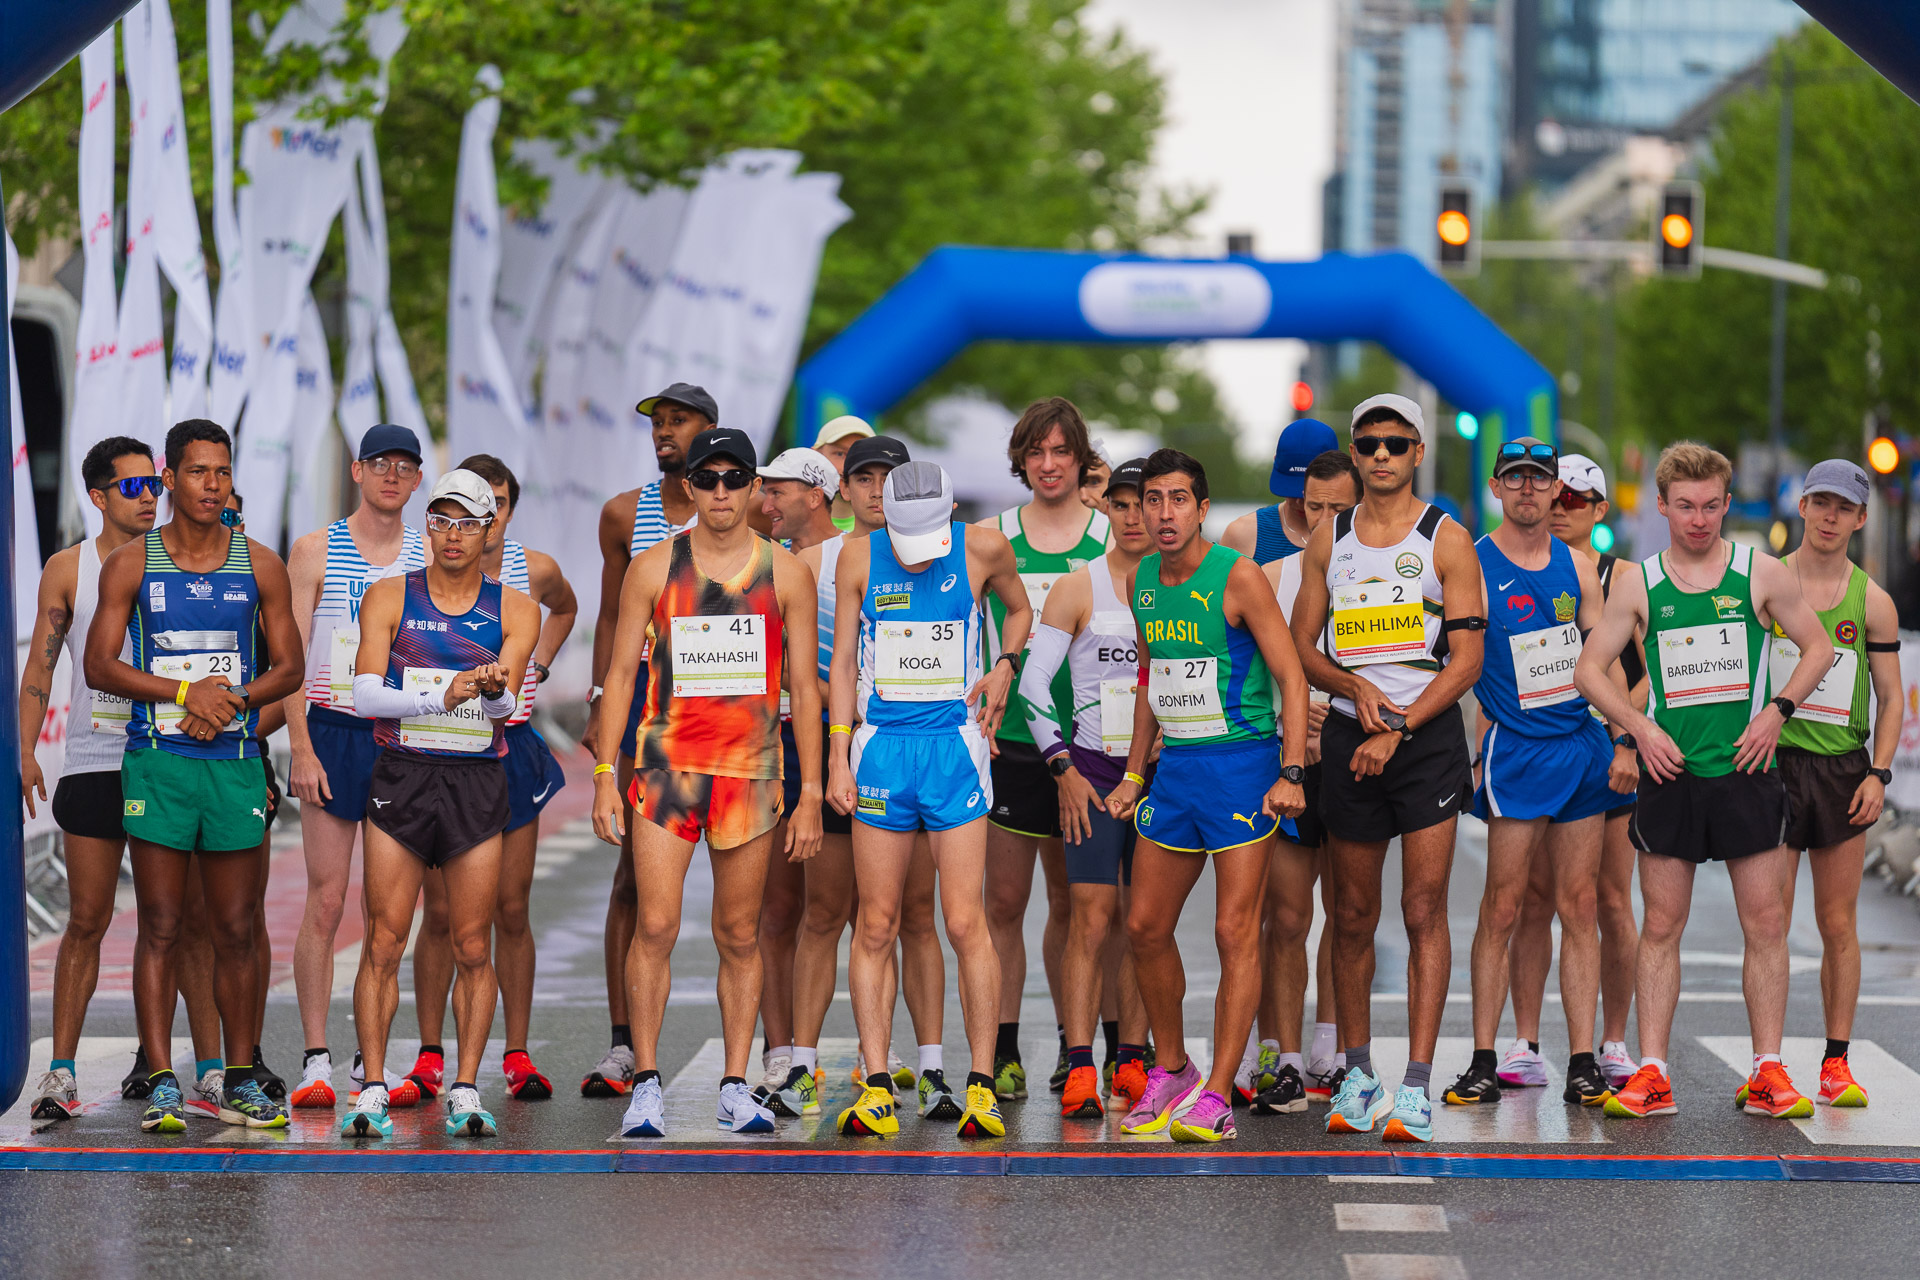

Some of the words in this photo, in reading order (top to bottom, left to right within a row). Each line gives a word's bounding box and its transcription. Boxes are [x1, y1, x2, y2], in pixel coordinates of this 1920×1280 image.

[1399, 556, 1419, 567] RKS
[872, 581, 914, 595] 大塚製薬
[1392, 585, 1405, 603] 2
[729, 618, 754, 635] 41
[931, 623, 954, 641] 35
[1145, 619, 1203, 646] BRASIL
[1336, 620, 1365, 636] BEN
[1369, 615, 1423, 633] HLIMA
[1561, 627, 1577, 646] 10
[1719, 628, 1731, 645] 1
[209, 656, 232, 673] 23
[679, 651, 758, 664] TAKAHASHI
[899, 657, 942, 670] KOGA
[1184, 661, 1208, 679] 27
[1667, 657, 1743, 678] BARBUŻYŃSKI
[1158, 693, 1206, 708] BONFIM
[436, 706, 485, 721] ANISHI
